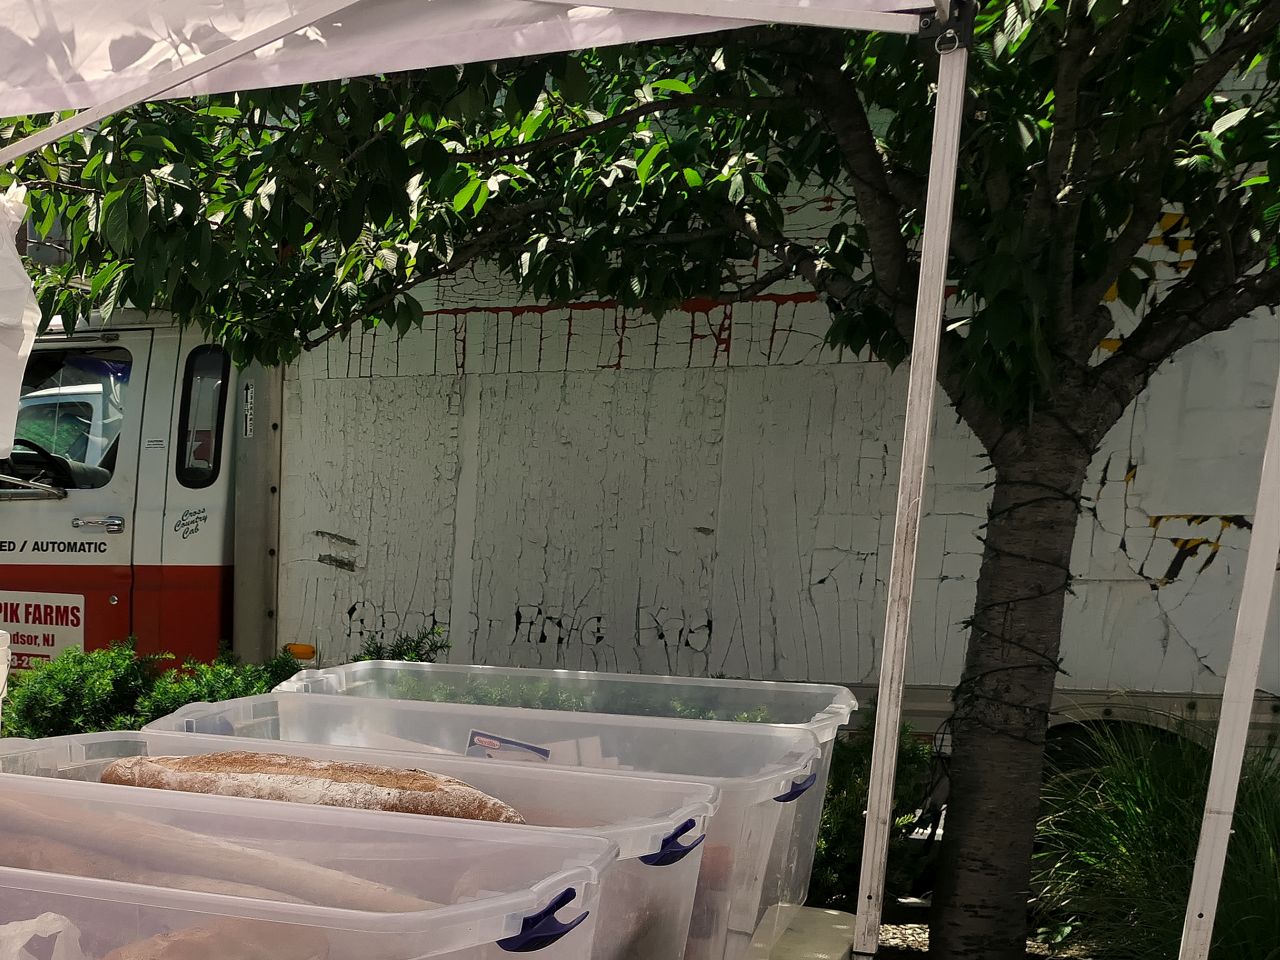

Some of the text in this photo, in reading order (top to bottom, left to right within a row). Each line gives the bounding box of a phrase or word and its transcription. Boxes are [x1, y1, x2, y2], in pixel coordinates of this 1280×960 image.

[181, 507, 206, 522] Cross
[174, 514, 208, 532] Country
[181, 525, 200, 539] Cab
[31, 541, 107, 553] AUTOMATIC
[24, 604, 81, 628] FARMS
[42, 633, 55, 647] NJ
